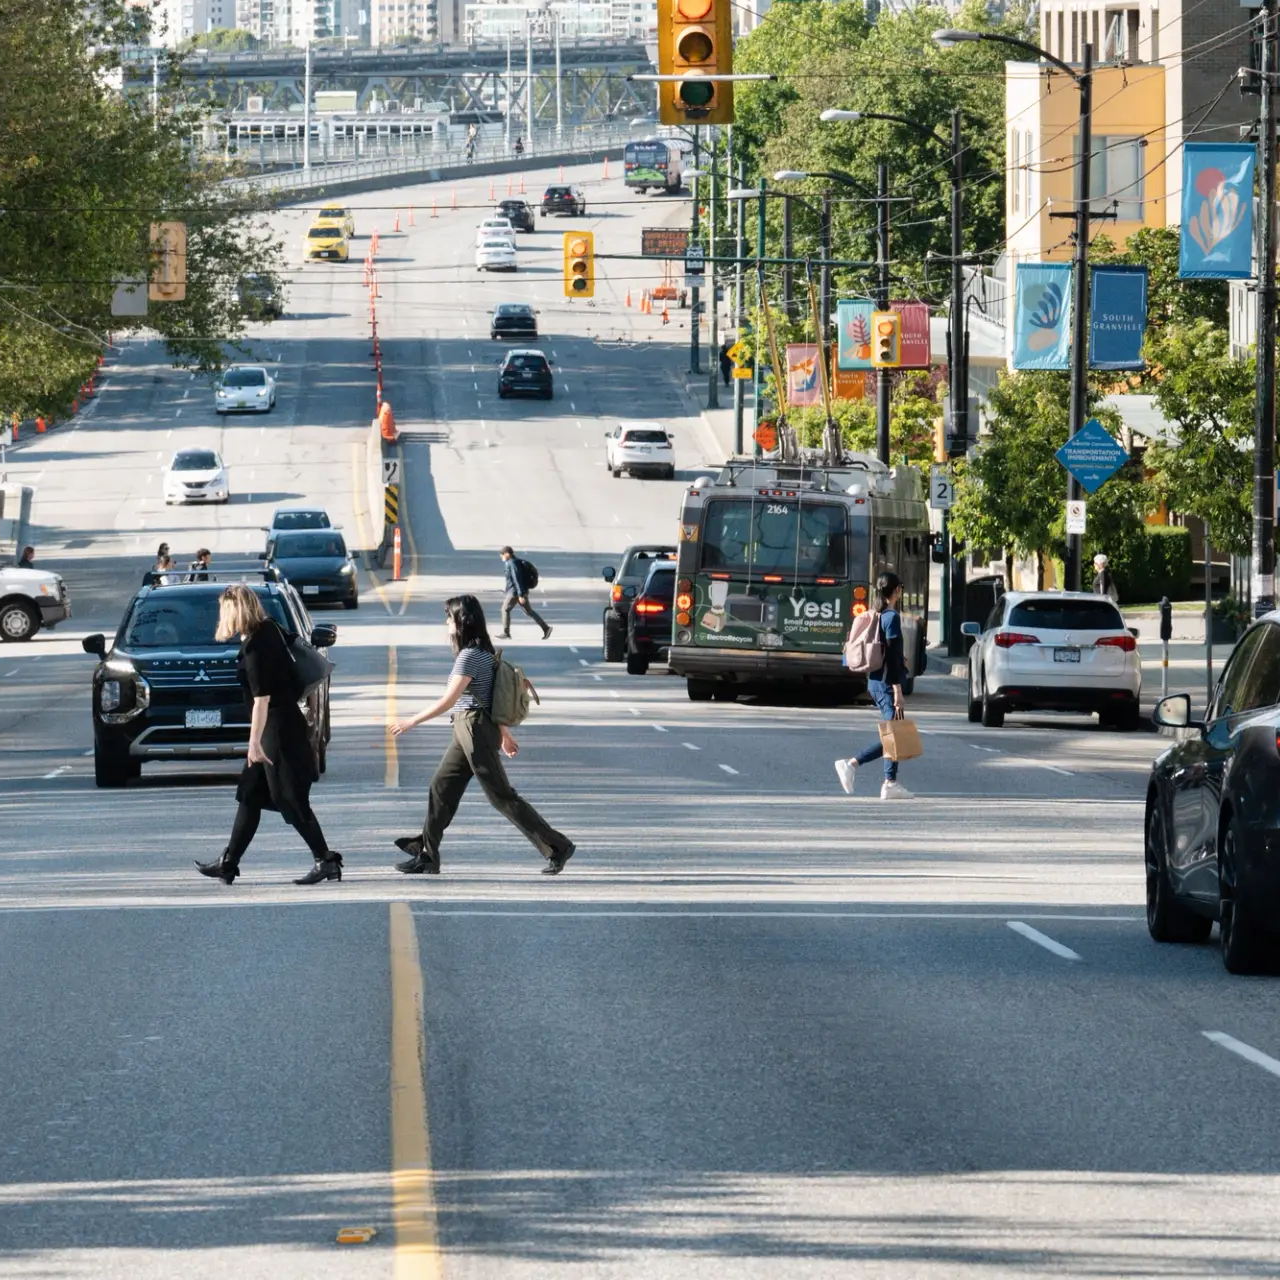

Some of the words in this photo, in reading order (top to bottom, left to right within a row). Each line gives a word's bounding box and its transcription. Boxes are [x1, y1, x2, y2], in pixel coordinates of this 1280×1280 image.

[1102, 314, 1134, 322] SOUTH
[1093, 321, 1142, 331] GRANVILLE
[1064, 448, 1121, 456] TRANSPORTATION
[767, 505, 788, 515] 2164
[789, 596, 841, 619] Yes!
[804, 619, 843, 628] appliances
[706, 634, 753, 643] ElectroRecycle
